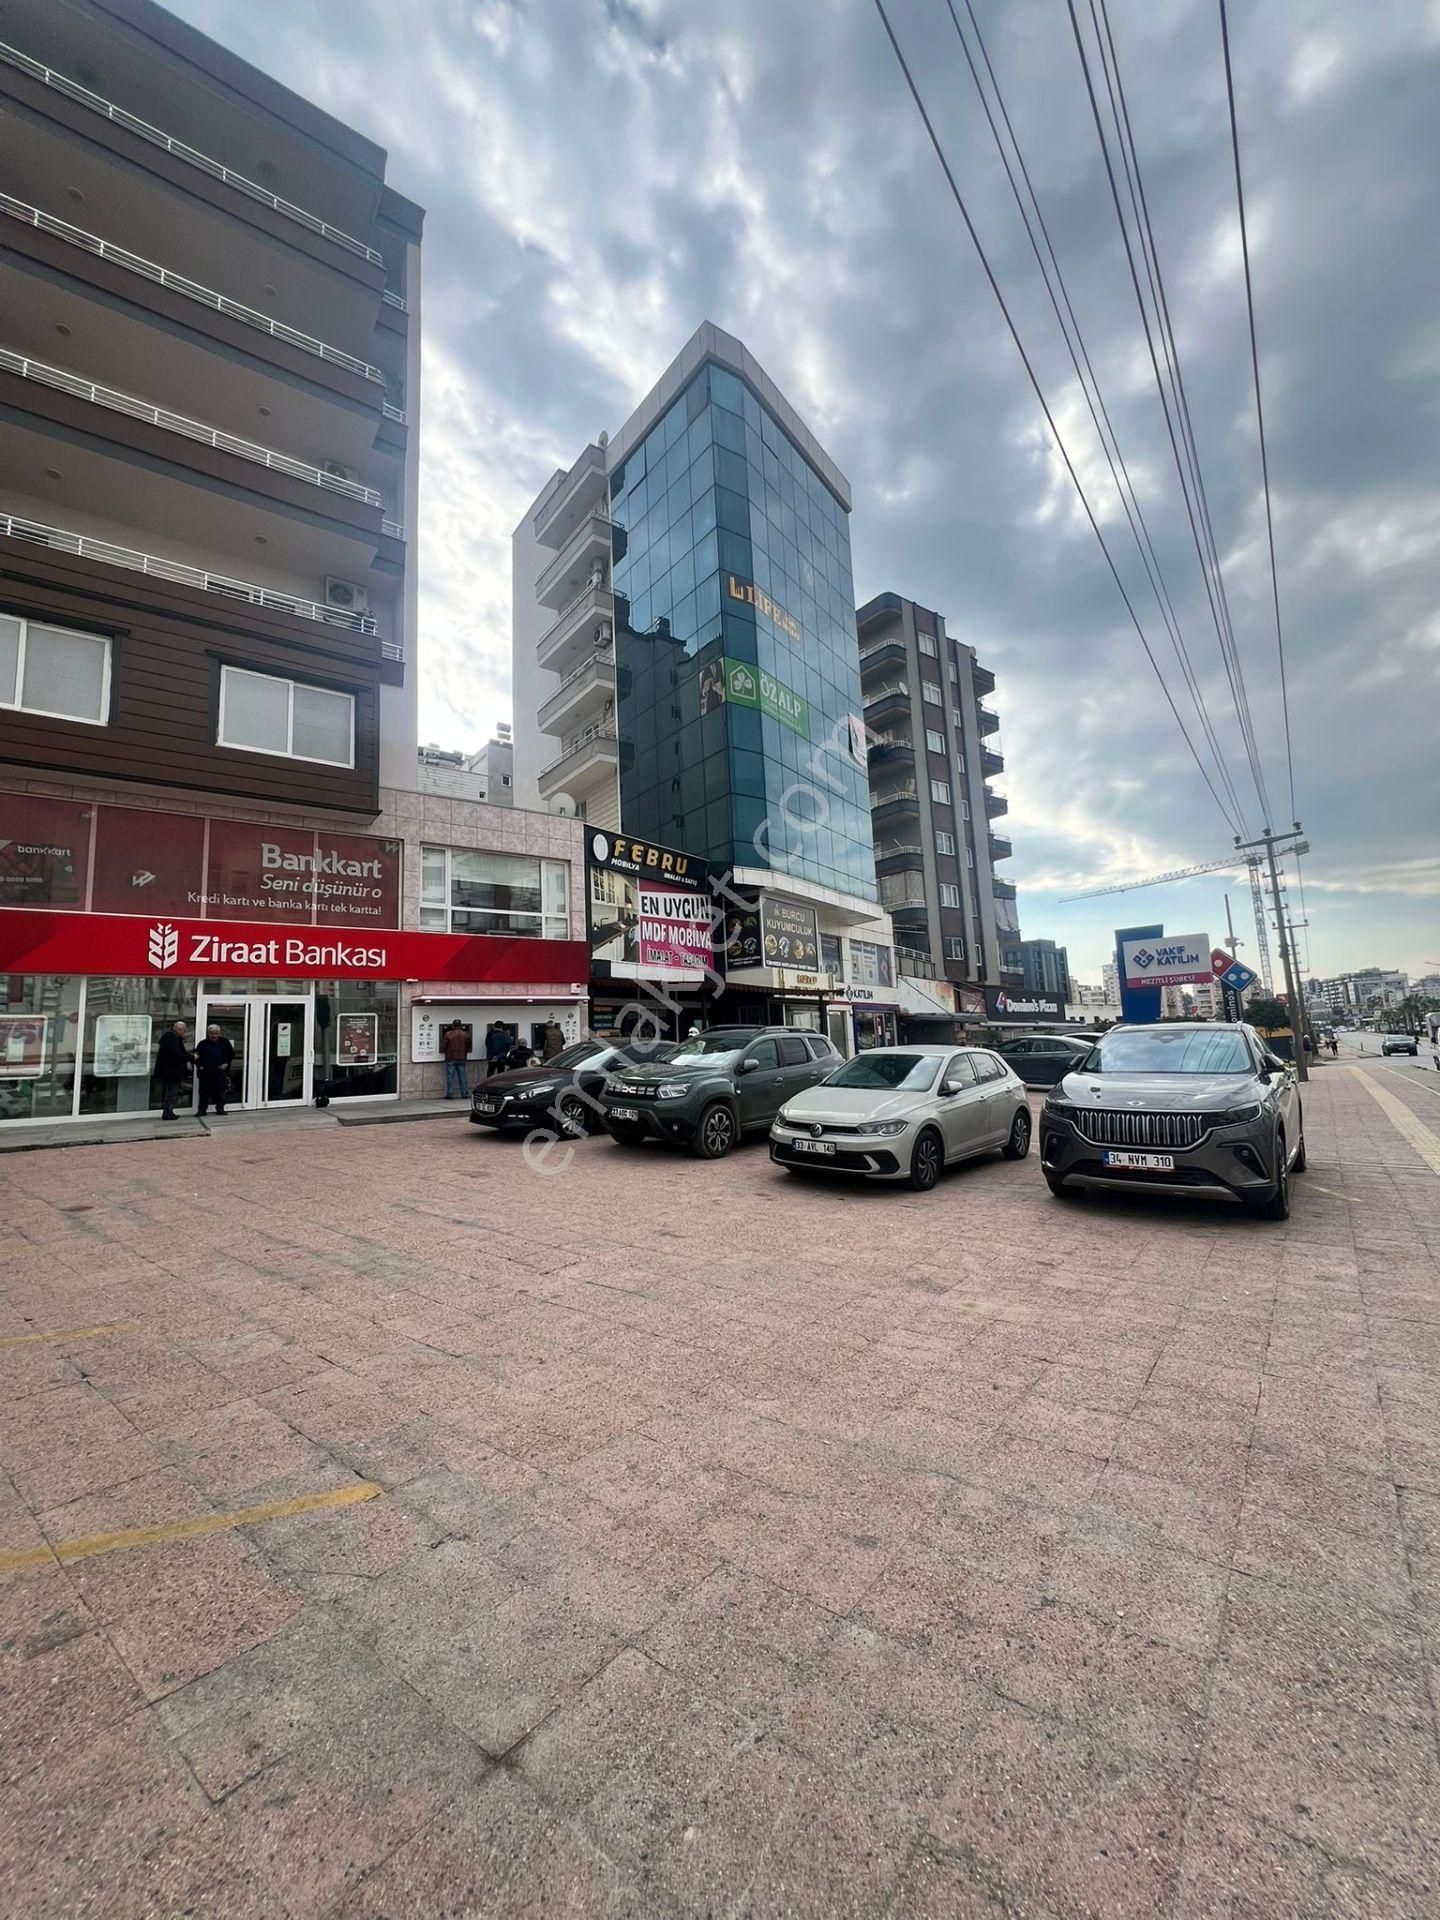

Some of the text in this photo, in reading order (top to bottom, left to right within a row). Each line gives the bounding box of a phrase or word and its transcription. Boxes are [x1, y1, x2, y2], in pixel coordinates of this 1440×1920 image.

[760, 673, 801, 718] ÖZALP
[17, 845, 71, 856] bankkart
[261, 843, 382, 879] Bankkart
[614, 839, 688, 875] FEBRU
[260, 874, 382, 899] Seni düşünür o
[188, 891, 382, 916] Kredi kartı ve banka kartı tek kartta!
[641, 895, 710, 919] EN UYGUN
[781, 908, 805, 922] BURCU
[642, 920, 712, 950] MDF MOBİLYA
[766, 918, 813, 937] KUYUMCULUK
[189, 934, 387, 967] Ziraat Bankası
[646, 944, 674, 965] İMALAT
[679, 951, 709, 968] TASARIM
[1156, 946, 1185, 957] VAKIF
[1157, 953, 1200, 966] KATILIM
[1006, 999, 1058, 1013] Domino's Pizza
[1225, 990, 1238, 1023] omino's
[1109, 1153, 1171, 1167] 34 NVM 310
